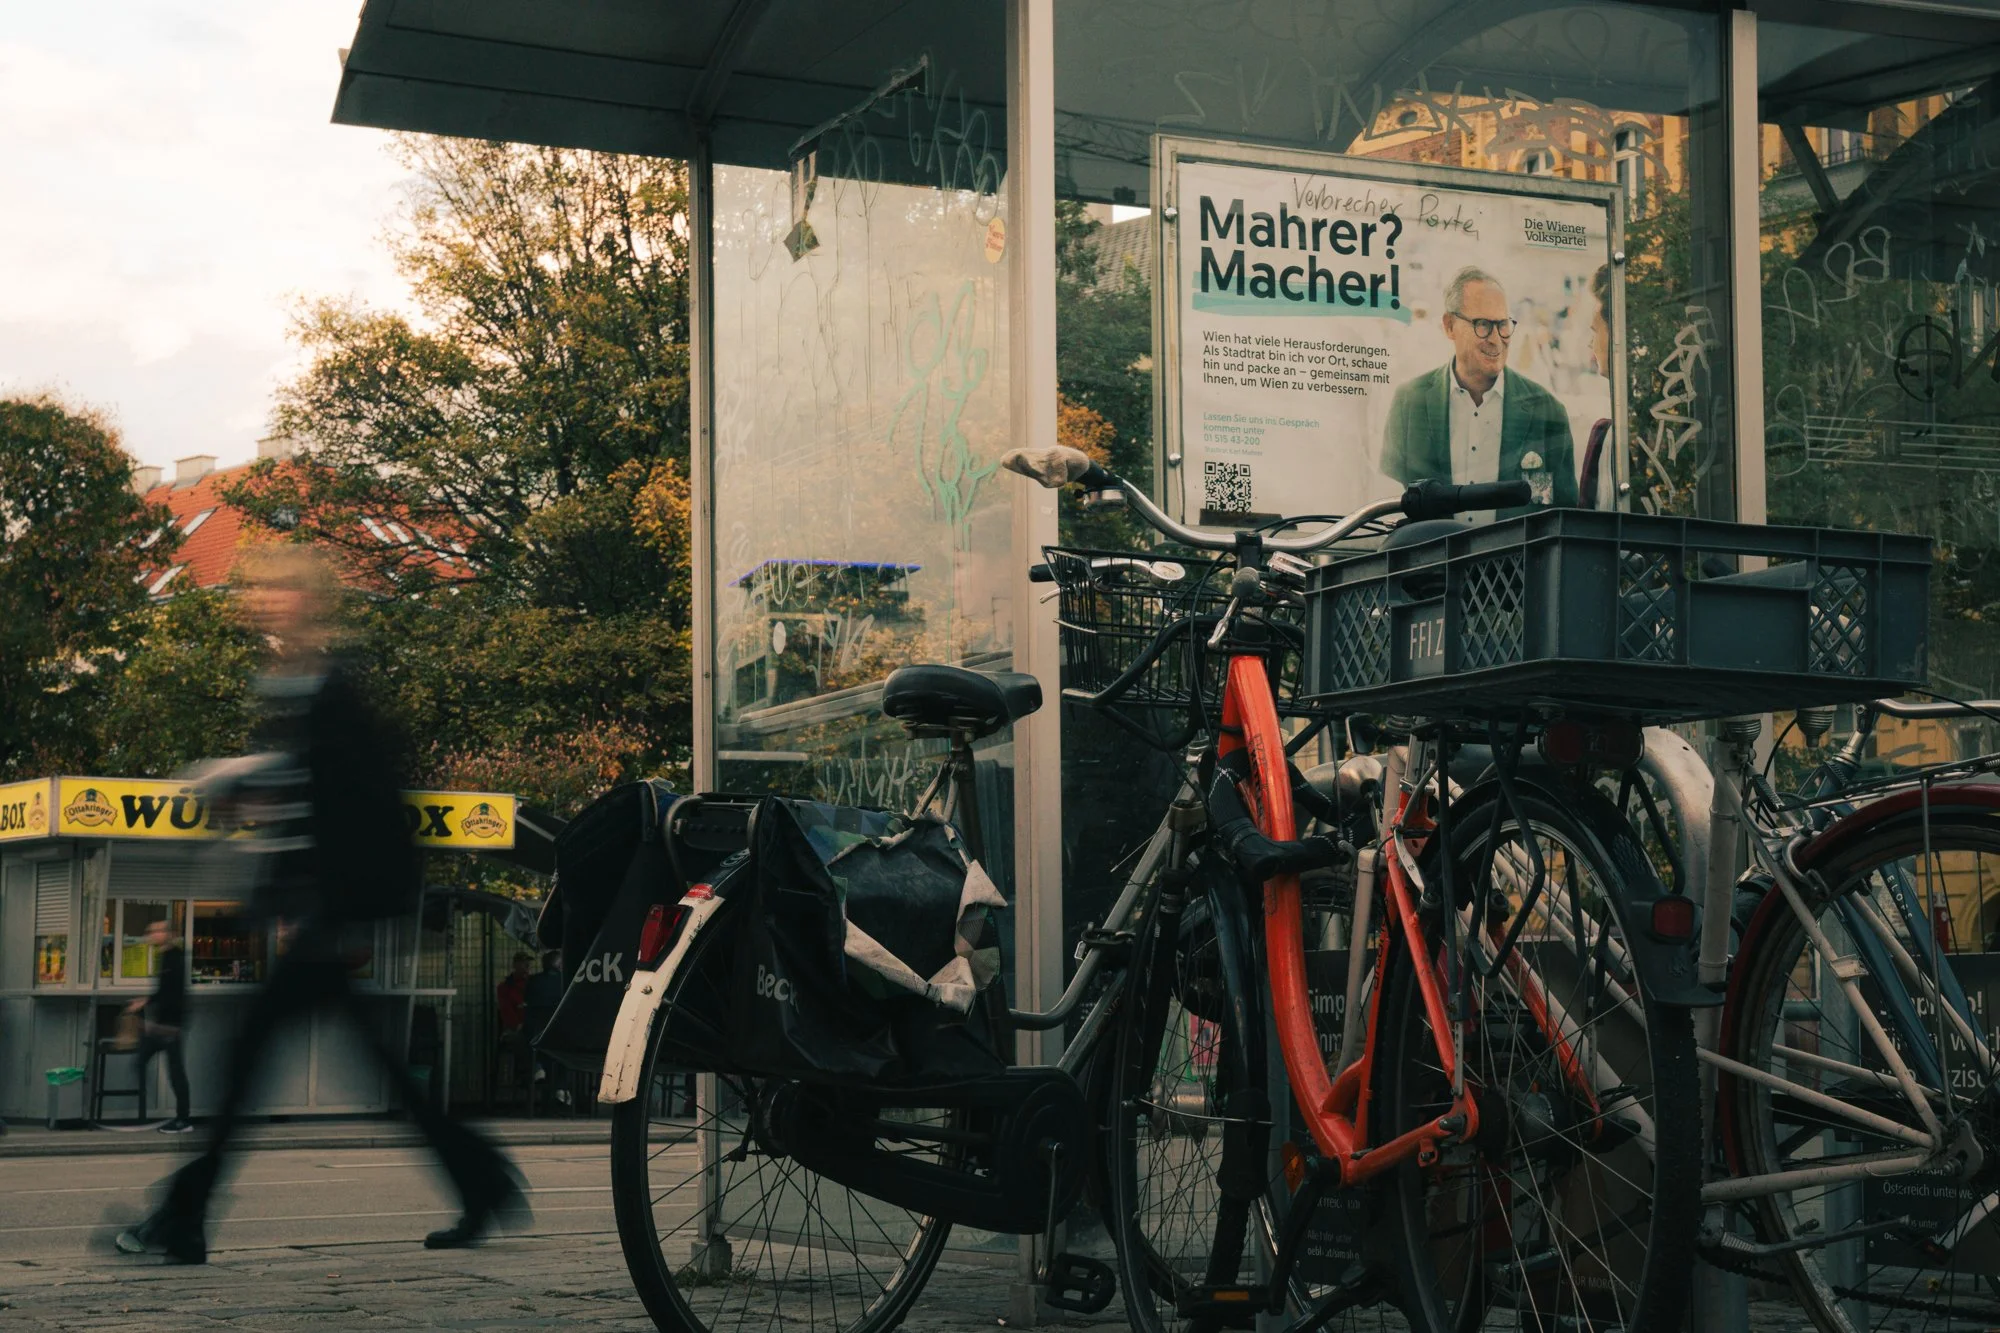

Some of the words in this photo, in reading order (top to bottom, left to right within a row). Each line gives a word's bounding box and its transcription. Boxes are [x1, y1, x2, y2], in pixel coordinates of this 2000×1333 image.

[1200, 195, 1403, 260] Mahrer?
[1524, 218, 1543, 230] Die
[1546, 221, 1586, 235] Wiener
[1525, 230, 1587, 247] Volkspartei
[1201, 246, 1400, 310] Macher!
[1203, 330, 1231, 344] Wien
[1234, 333, 1252, 345] hat
[1255, 335, 1280, 347] viele
[1284, 337, 1390, 357] Herausforderungen.
[1203, 345, 1219, 356] Als
[1223, 346, 1265, 360] Stadtrat
[1269, 350, 1286, 361] bin
[1289, 351, 1304, 363] ich
[1308, 355, 1325, 364] vor
[1328, 355, 1349, 368] Ort,
[1351, 357, 1387, 370] schaue
[1203, 359, 1220, 370] hin
[1223, 361, 1244, 372] und
[1247, 363, 1280, 375] packe
[1283, 367, 1296, 376] an
[1310, 369, 1370, 382] gemeinsam
[1373, 373, 1390, 384] mit
[1203, 372, 1237, 387] Ihnen,
[1241, 378, 1257, 387] um
[1260, 377, 1289, 390] Wien
[1291, 381, 1304, 390] zu
[1307, 381, 1368, 396] verbessern.
[1203, 412, 1232, 422] Lassen
[1233, 414, 1247, 423] Sie
[1249, 416, 1263, 424] uns
[1265, 416, 1277, 425] ins
[1279, 417, 1320, 429] Gespräch
[1203, 423, 1241, 433] kommen
[1243, 426, 1265, 435] unter
[1204, 434, 1212, 442] 01
[1214, 435, 1228, 444] 515
[1230, 436, 1260, 446] 43-200
[1, 801, 27, 831] BOX
[67, 801, 113, 818] Ottakringer
[120, 787, 212, 830] WÜ
